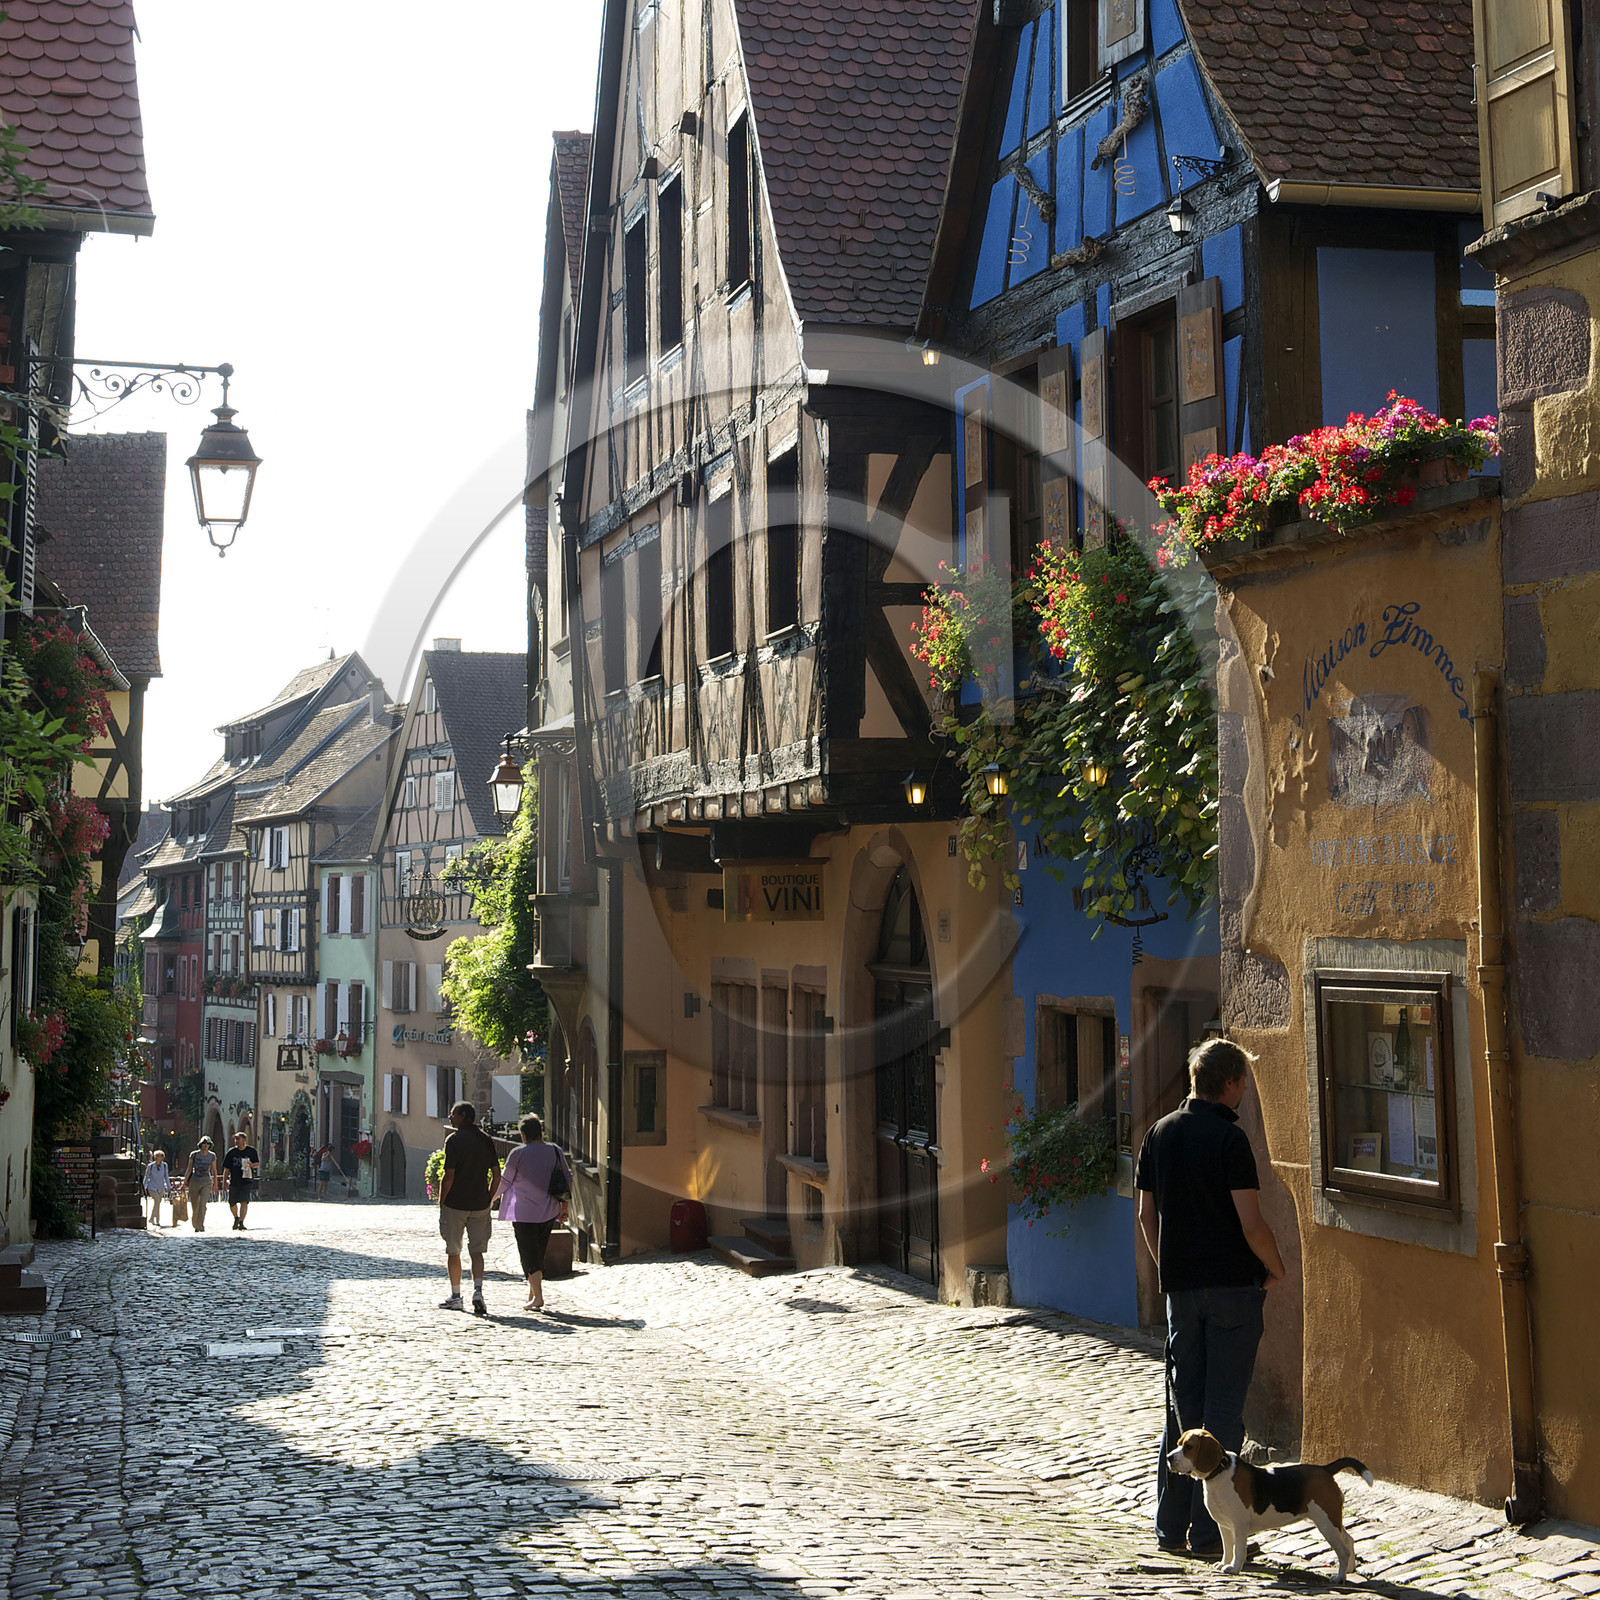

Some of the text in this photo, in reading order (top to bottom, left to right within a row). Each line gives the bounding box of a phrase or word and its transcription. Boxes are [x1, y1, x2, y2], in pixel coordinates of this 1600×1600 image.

[1290, 601, 1474, 746] Maison Zimmer
[1310, 839, 1342, 867] VINS
[1346, 835, 1379, 866] FINS
[761, 874, 820, 886] BOUTIQUE
[763, 887, 821, 912] VINI
[403, 1029, 450, 1045] CRÉDIT AGRICOLE
